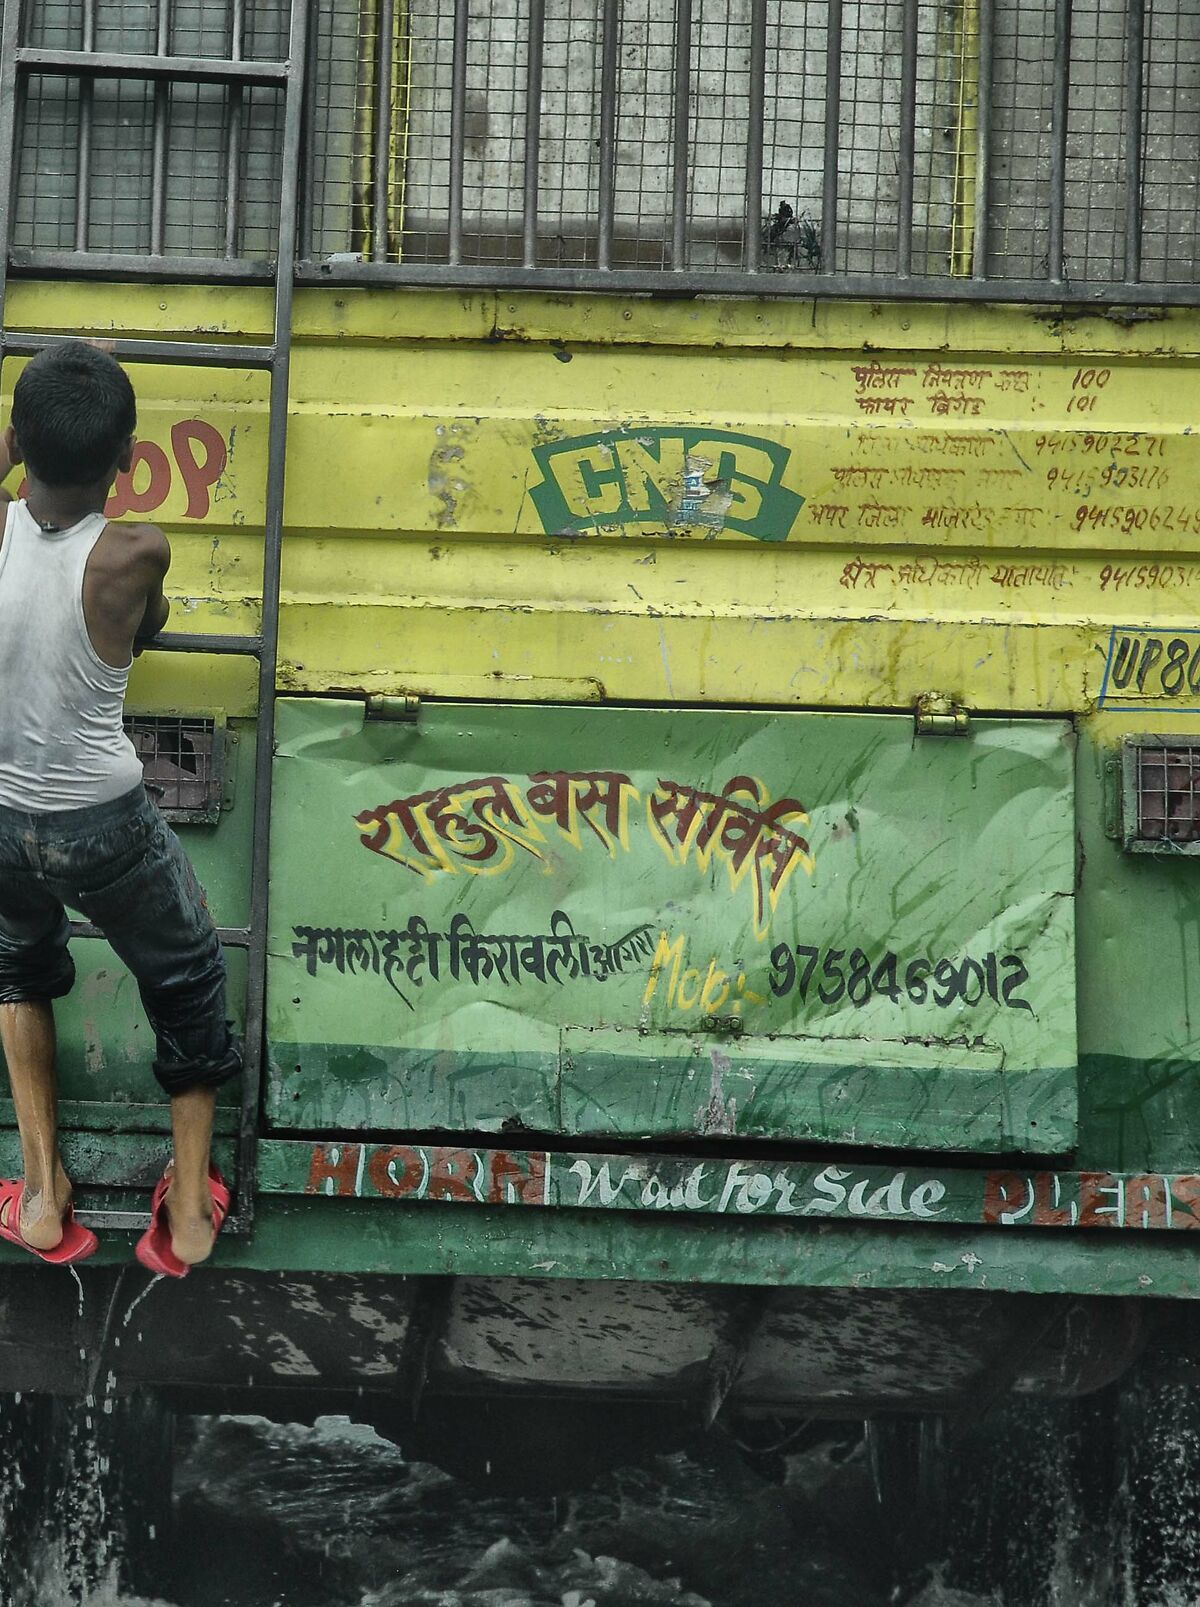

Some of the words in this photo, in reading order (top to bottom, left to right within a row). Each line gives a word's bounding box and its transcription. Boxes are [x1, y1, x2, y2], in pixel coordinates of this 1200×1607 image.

[851, 360, 917, 394] पुलिस
[1072, 368, 1110, 390] 100
[1066, 397, 1097, 413] 101
[352, 775, 553, 884] राहुल
[527, 771, 640, 860] बस
[443, 909, 591, 988] किरावली
[768, 941, 1040, 1021] 9758469012
[304, 1144, 551, 1205] HORN
[802, 1165, 948, 1218] Side
